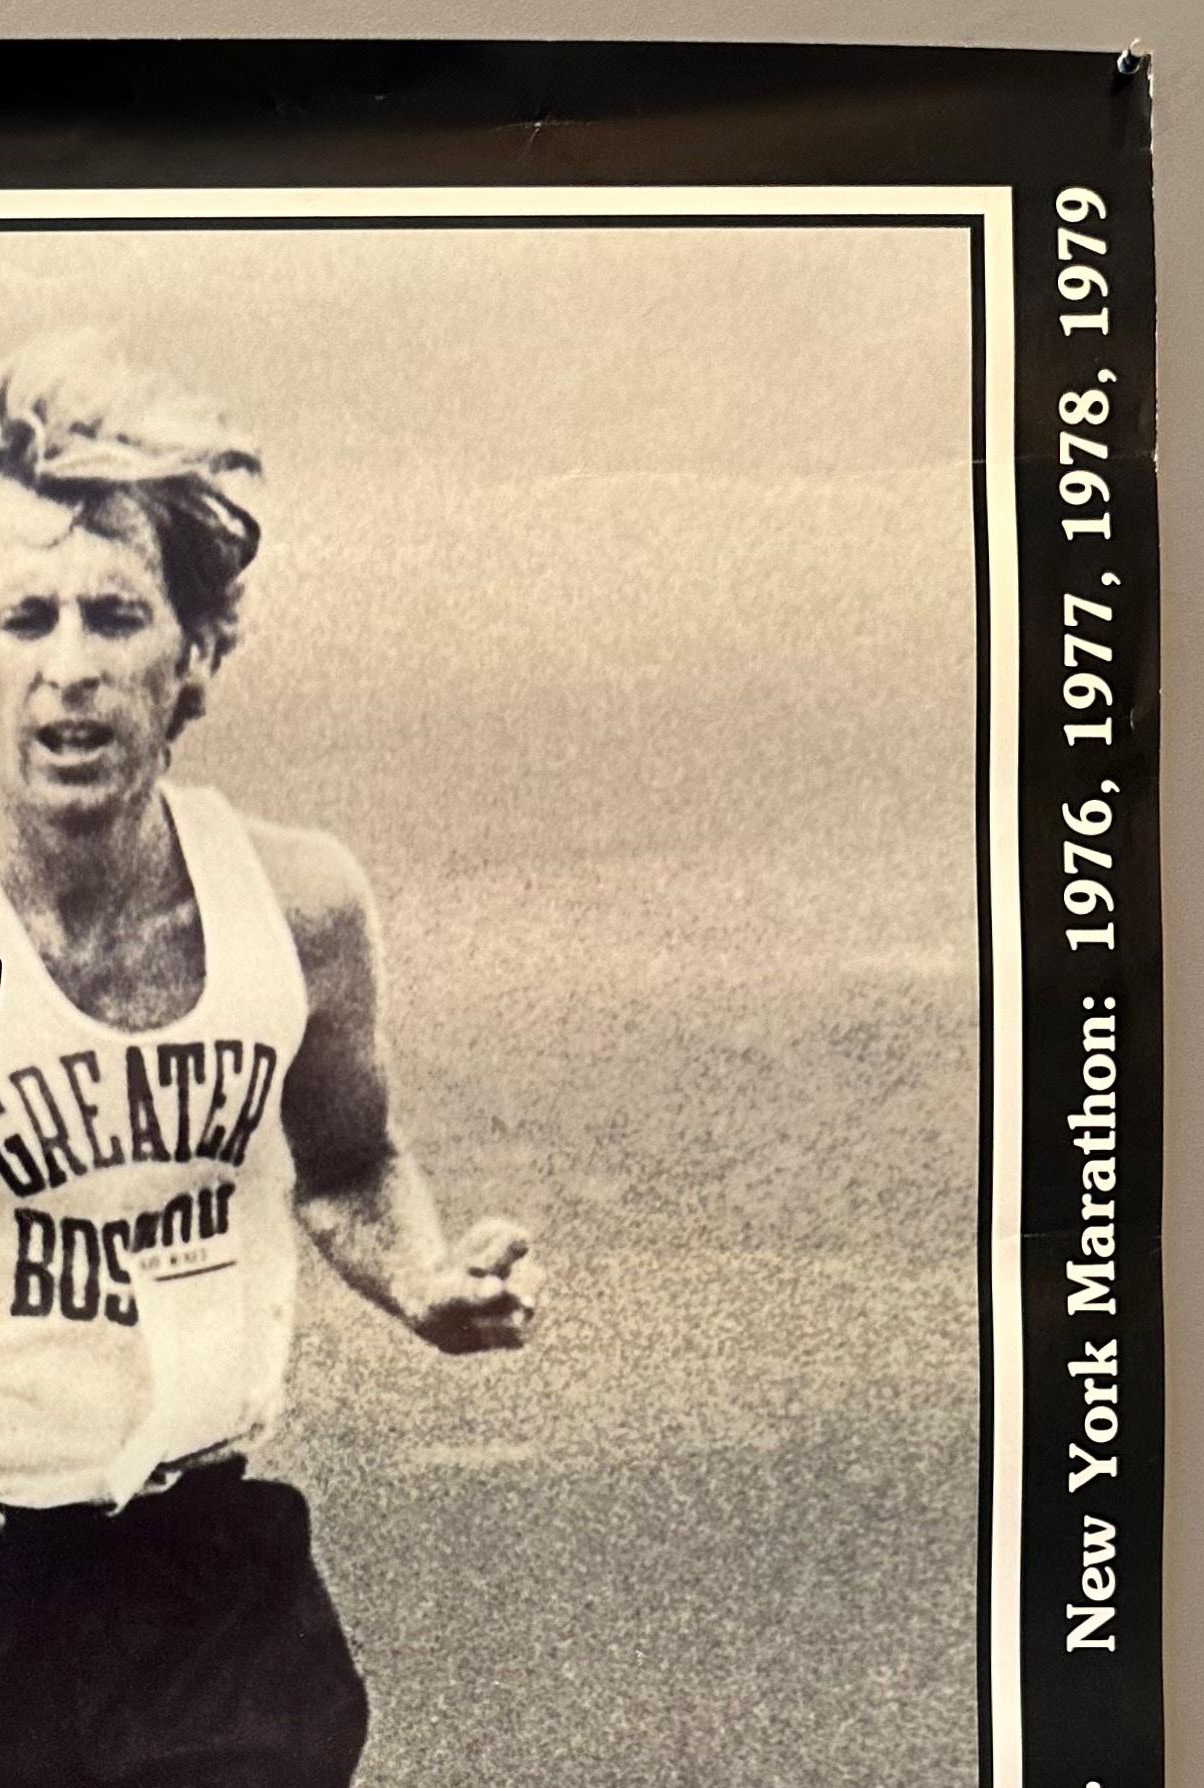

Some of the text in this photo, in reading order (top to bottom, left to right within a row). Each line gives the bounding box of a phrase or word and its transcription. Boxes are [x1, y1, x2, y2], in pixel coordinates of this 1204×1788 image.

[1056, 188, 1109, 336] 1979
[1059, 369, 1117, 540] 1978,
[1062, 573, 1121, 746] 1977,
[1062, 780, 1121, 950] 1976,
[1066, 997, 1116, 1315] Marathon:
[1068, 1339, 1118, 1492] York
[1067, 1515, 1115, 1652] New
